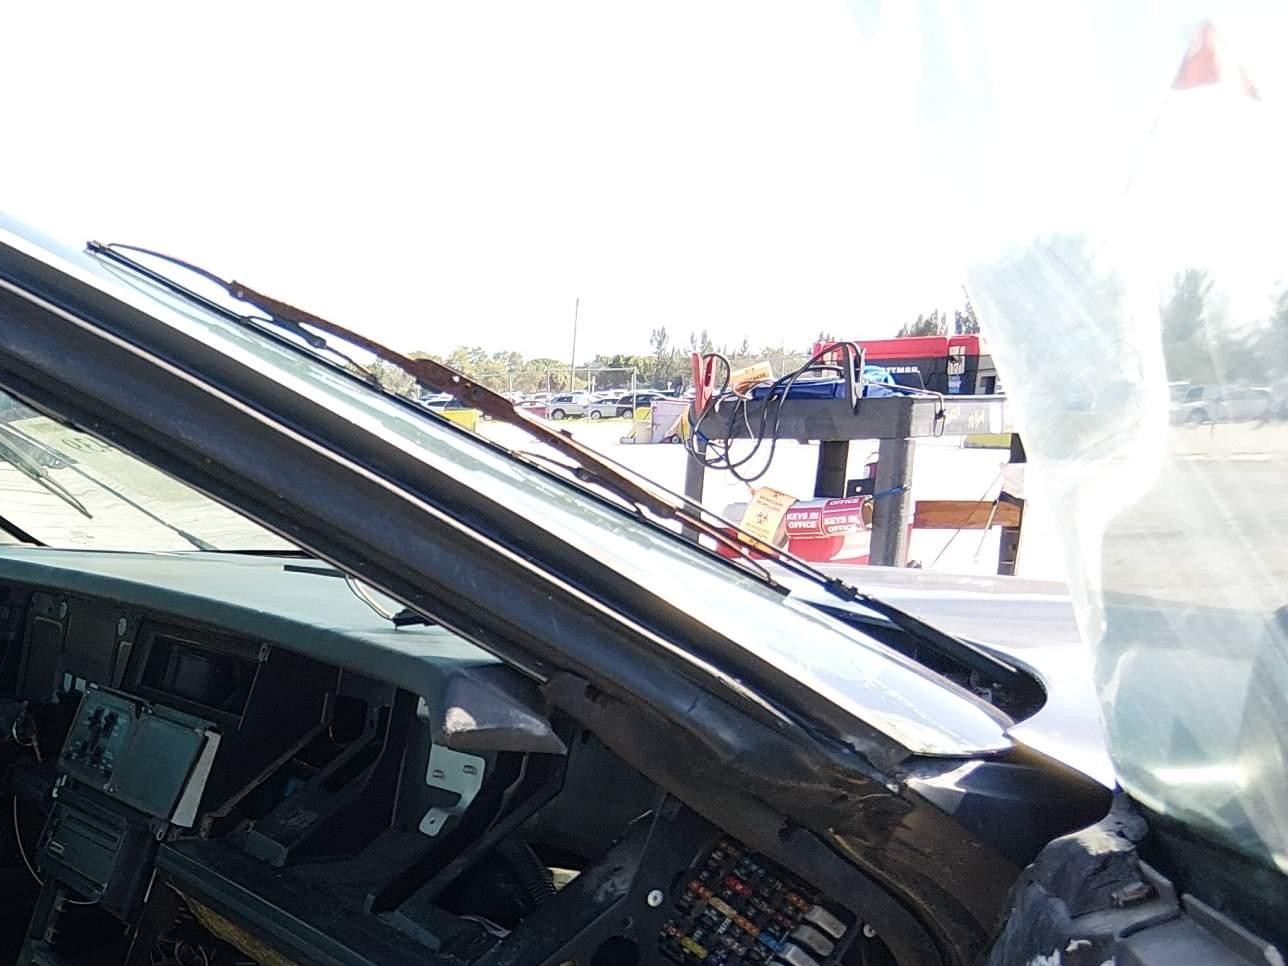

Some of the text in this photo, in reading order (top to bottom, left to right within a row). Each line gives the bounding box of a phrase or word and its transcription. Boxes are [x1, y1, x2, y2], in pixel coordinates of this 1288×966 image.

[787, 511, 819, 520] KEYS IN
[824, 515, 859, 525] KEYS IN
[788, 520, 817, 529] OFFICE
